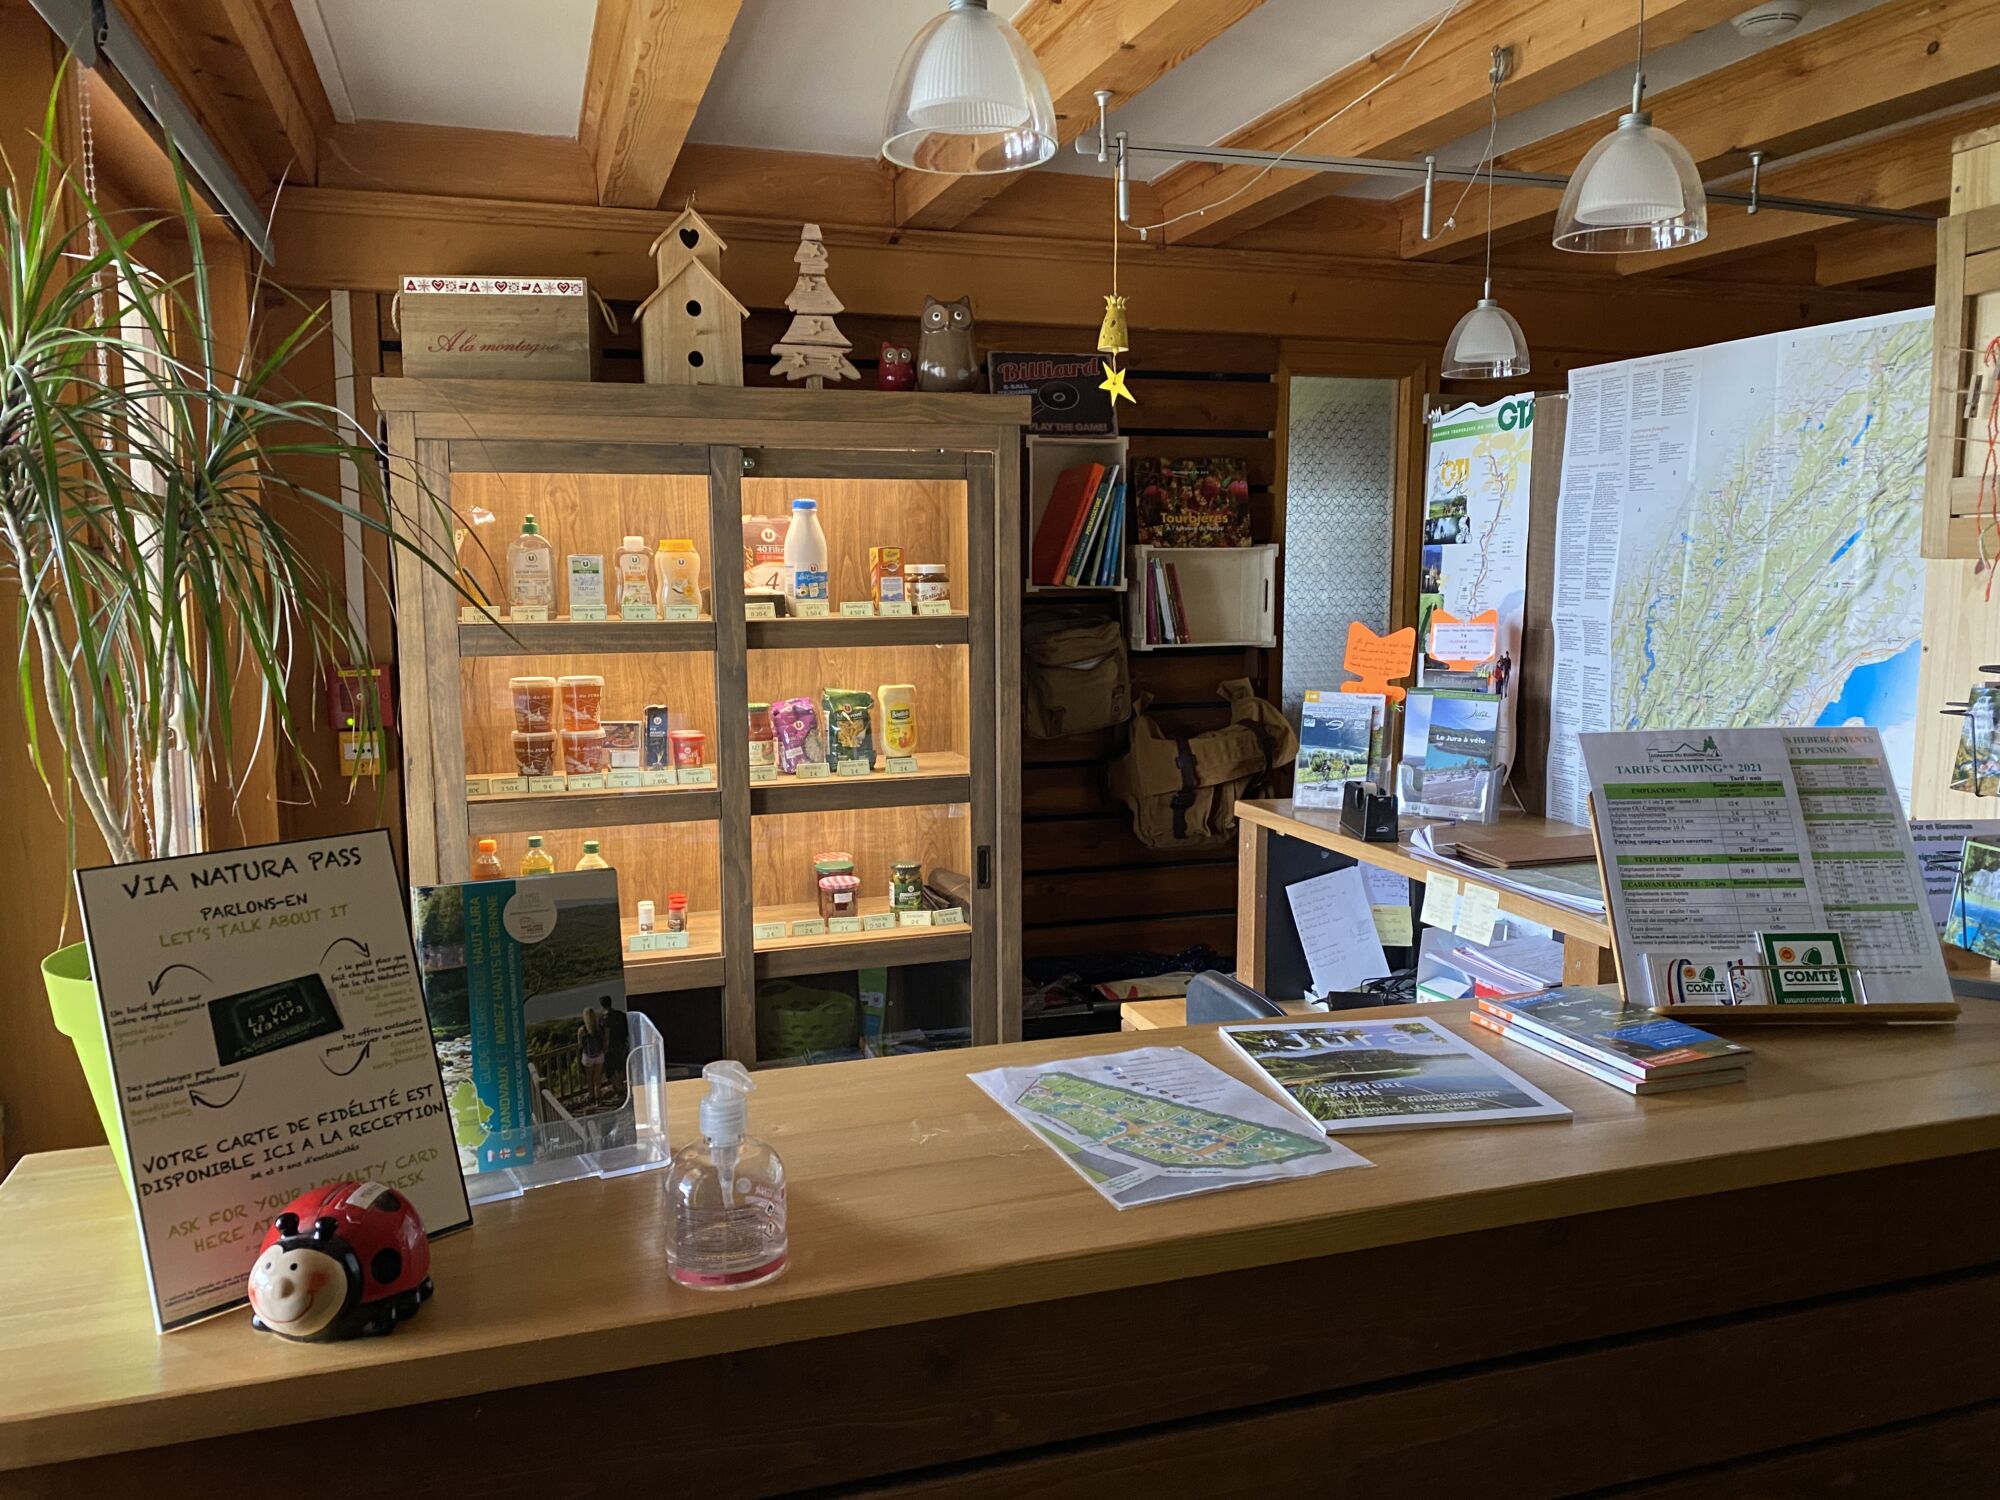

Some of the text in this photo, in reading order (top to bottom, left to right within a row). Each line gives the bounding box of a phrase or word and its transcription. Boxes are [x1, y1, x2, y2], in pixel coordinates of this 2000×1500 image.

[480, 338, 562, 358] montagne
[997, 357, 1101, 383] Billiard
[1057, 422, 1074, 432] THE
[1075, 422, 1108, 432] GAME!
[765, 571, 780, 590] 4
[1464, 735, 1469, 743] à
[1470, 736, 1486, 744] vélo
[1792, 736, 1874, 744] HEBERGEMENTS
[1615, 763, 1660, 775] TARIFS
[1738, 763, 1762, 772] 2021
[122, 847, 361, 899] VIA NATURA PASS
[200, 893, 308, 920] PARLONS-EN
[486, 895, 500, 937] BIENNE
[159, 904, 348, 948] LET'S TALK ABOUT IT
[489, 942, 502, 957] DE
[376, 962, 410, 975] camping
[490, 960, 505, 1000] HAUTS
[469, 896, 492, 1085] GUIDE TOURISTIQUE HAUT-JURA
[248, 1000, 293, 1028] La Via
[252, 1005, 304, 1038] Natura
[494, 1003, 508, 1045] MOREZ
[358, 1026, 382, 1037] offres
[1309, 1080, 1405, 1093] L'AVENTURE
[1315, 1089, 1383, 1100] NATURE
[497, 1066, 513, 1141] GRANDVAUX
[142, 1084, 433, 1174] VOTRE CARTE DE FIDÉLITÉ EST
[139, 1101, 443, 1197] DISPONIBLE ICI A LA RECEPTION
[168, 1148, 439, 1240] ASK FOR YOUR CARD
[193, 1222, 245, 1254] HERE
